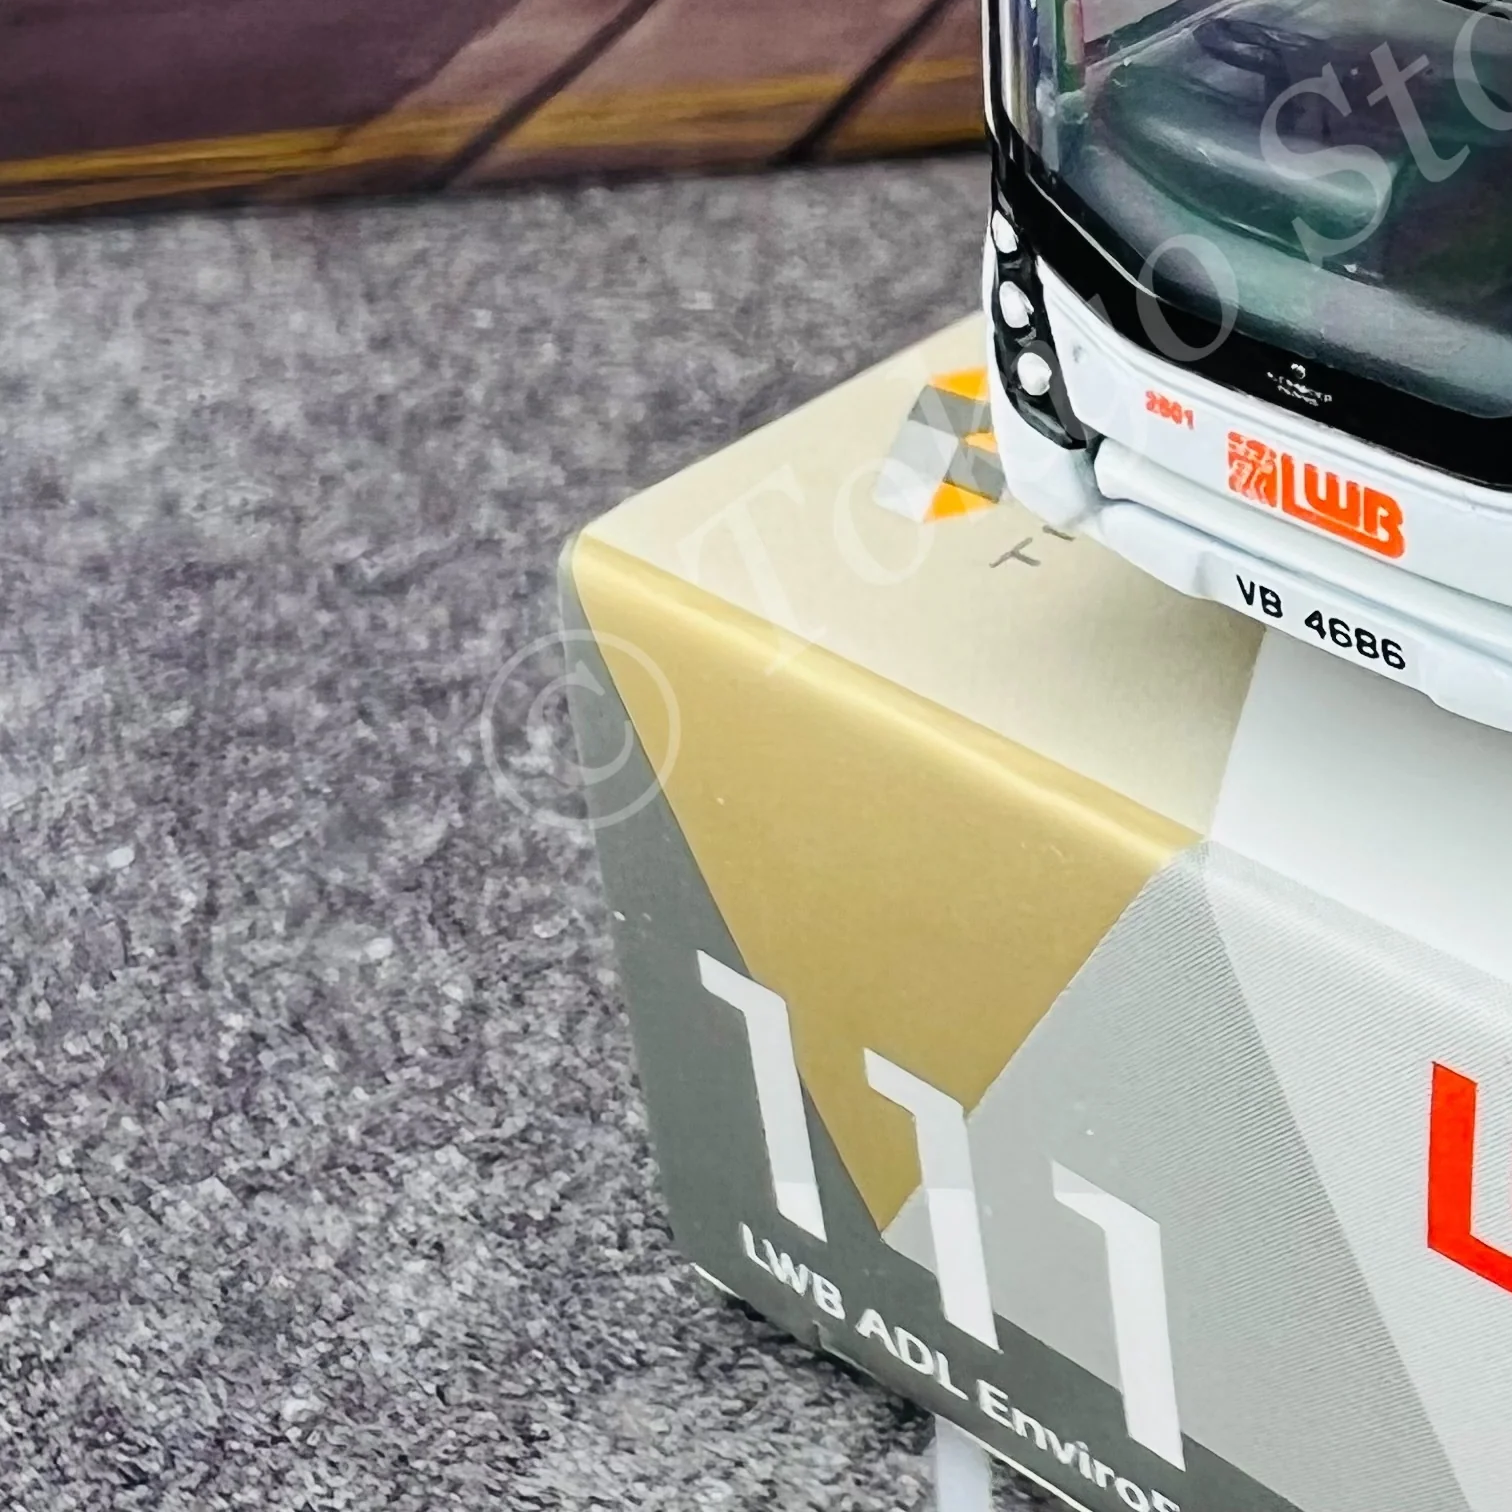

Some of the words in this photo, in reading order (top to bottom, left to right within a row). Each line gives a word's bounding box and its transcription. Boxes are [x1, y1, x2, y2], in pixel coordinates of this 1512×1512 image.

[1281, 452, 1405, 559] LWB
[1236, 575, 1283, 618] VB
[1304, 610, 1406, 670] 4686
[697, 949, 1186, 1472] 111
[740, 1222, 845, 1320] LWB
[856, 1309, 969, 1401] ADL
